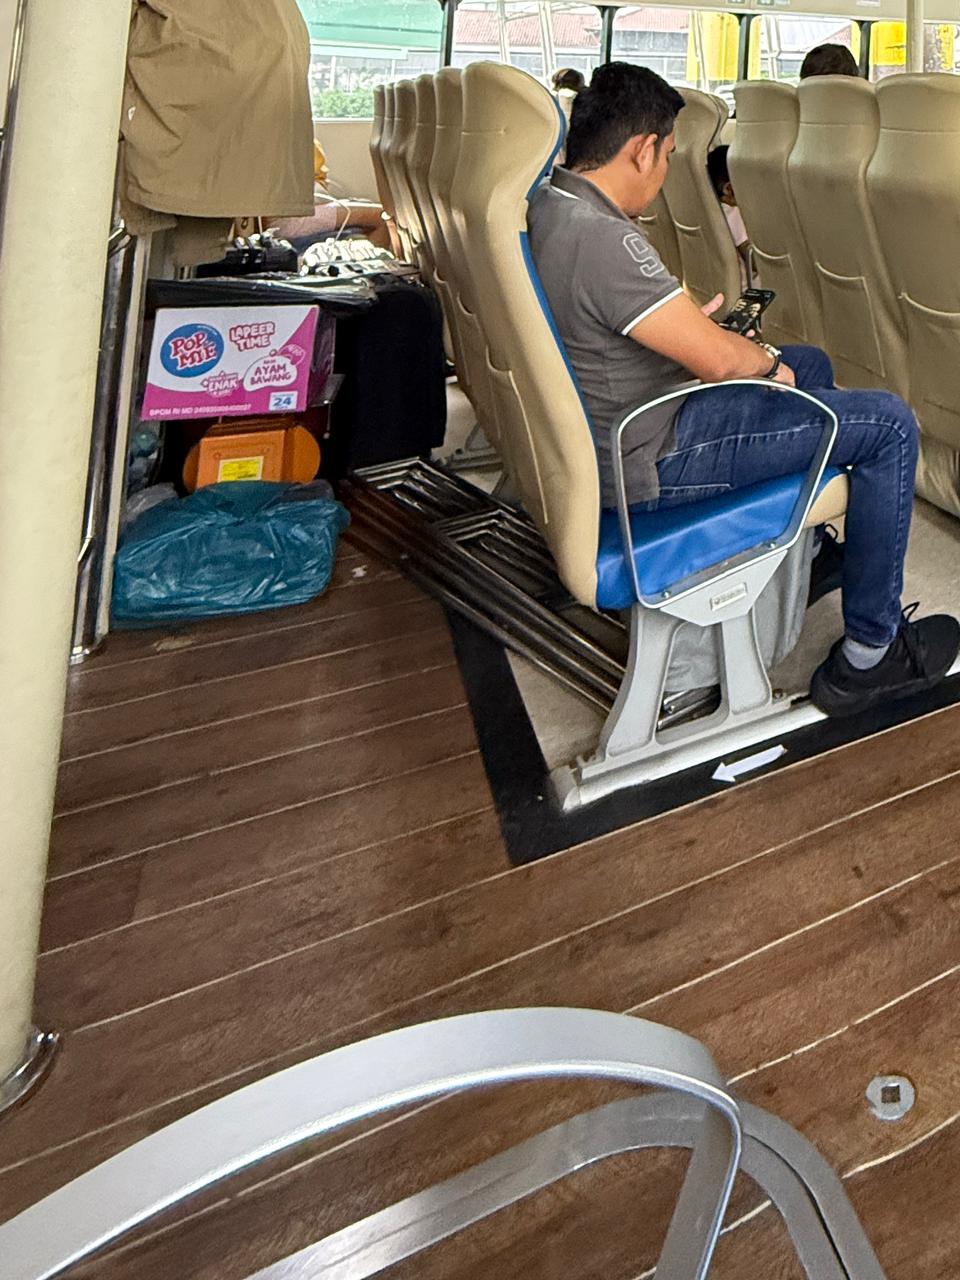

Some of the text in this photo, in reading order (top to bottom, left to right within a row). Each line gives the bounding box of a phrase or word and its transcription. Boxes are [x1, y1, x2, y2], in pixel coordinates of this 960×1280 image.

[229, 322, 275, 342] LAPEER
[170, 332, 206, 357] POP
[236, 335, 271, 351] TIME
[178, 347, 217, 369] MIE
[254, 363, 287, 375] AYAM
[208, 379, 239, 392] ENAK
[250, 373, 291, 385] BAWANG
[274, 396, 292, 406] 24
